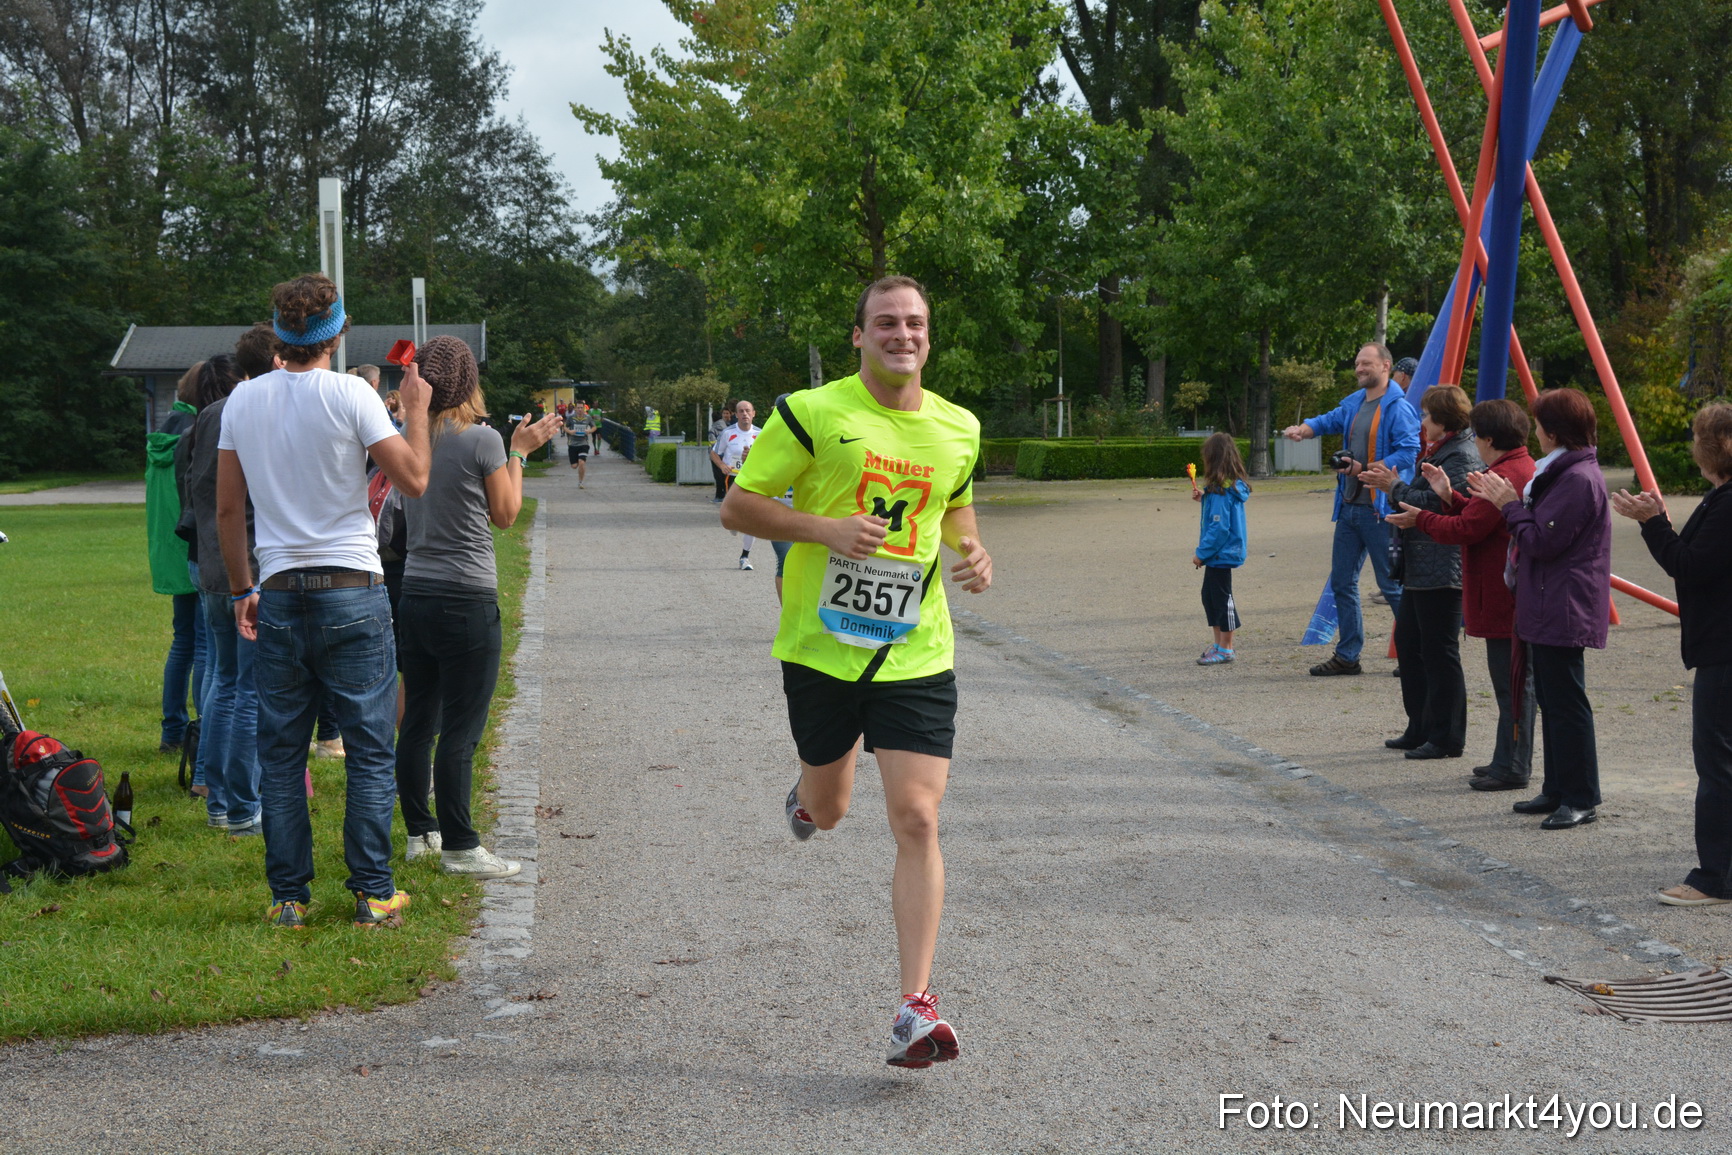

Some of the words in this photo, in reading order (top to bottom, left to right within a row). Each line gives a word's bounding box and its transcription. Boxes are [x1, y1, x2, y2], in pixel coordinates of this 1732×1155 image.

[864, 451, 934, 478] Müller
[872, 496, 908, 532] M
[829, 556, 862, 573] PARTL
[864, 565, 909, 580] Neumarkt
[822, 600, 827, 608] A
[830, 573, 915, 618] 2557
[840, 617, 896, 640] Dominik
